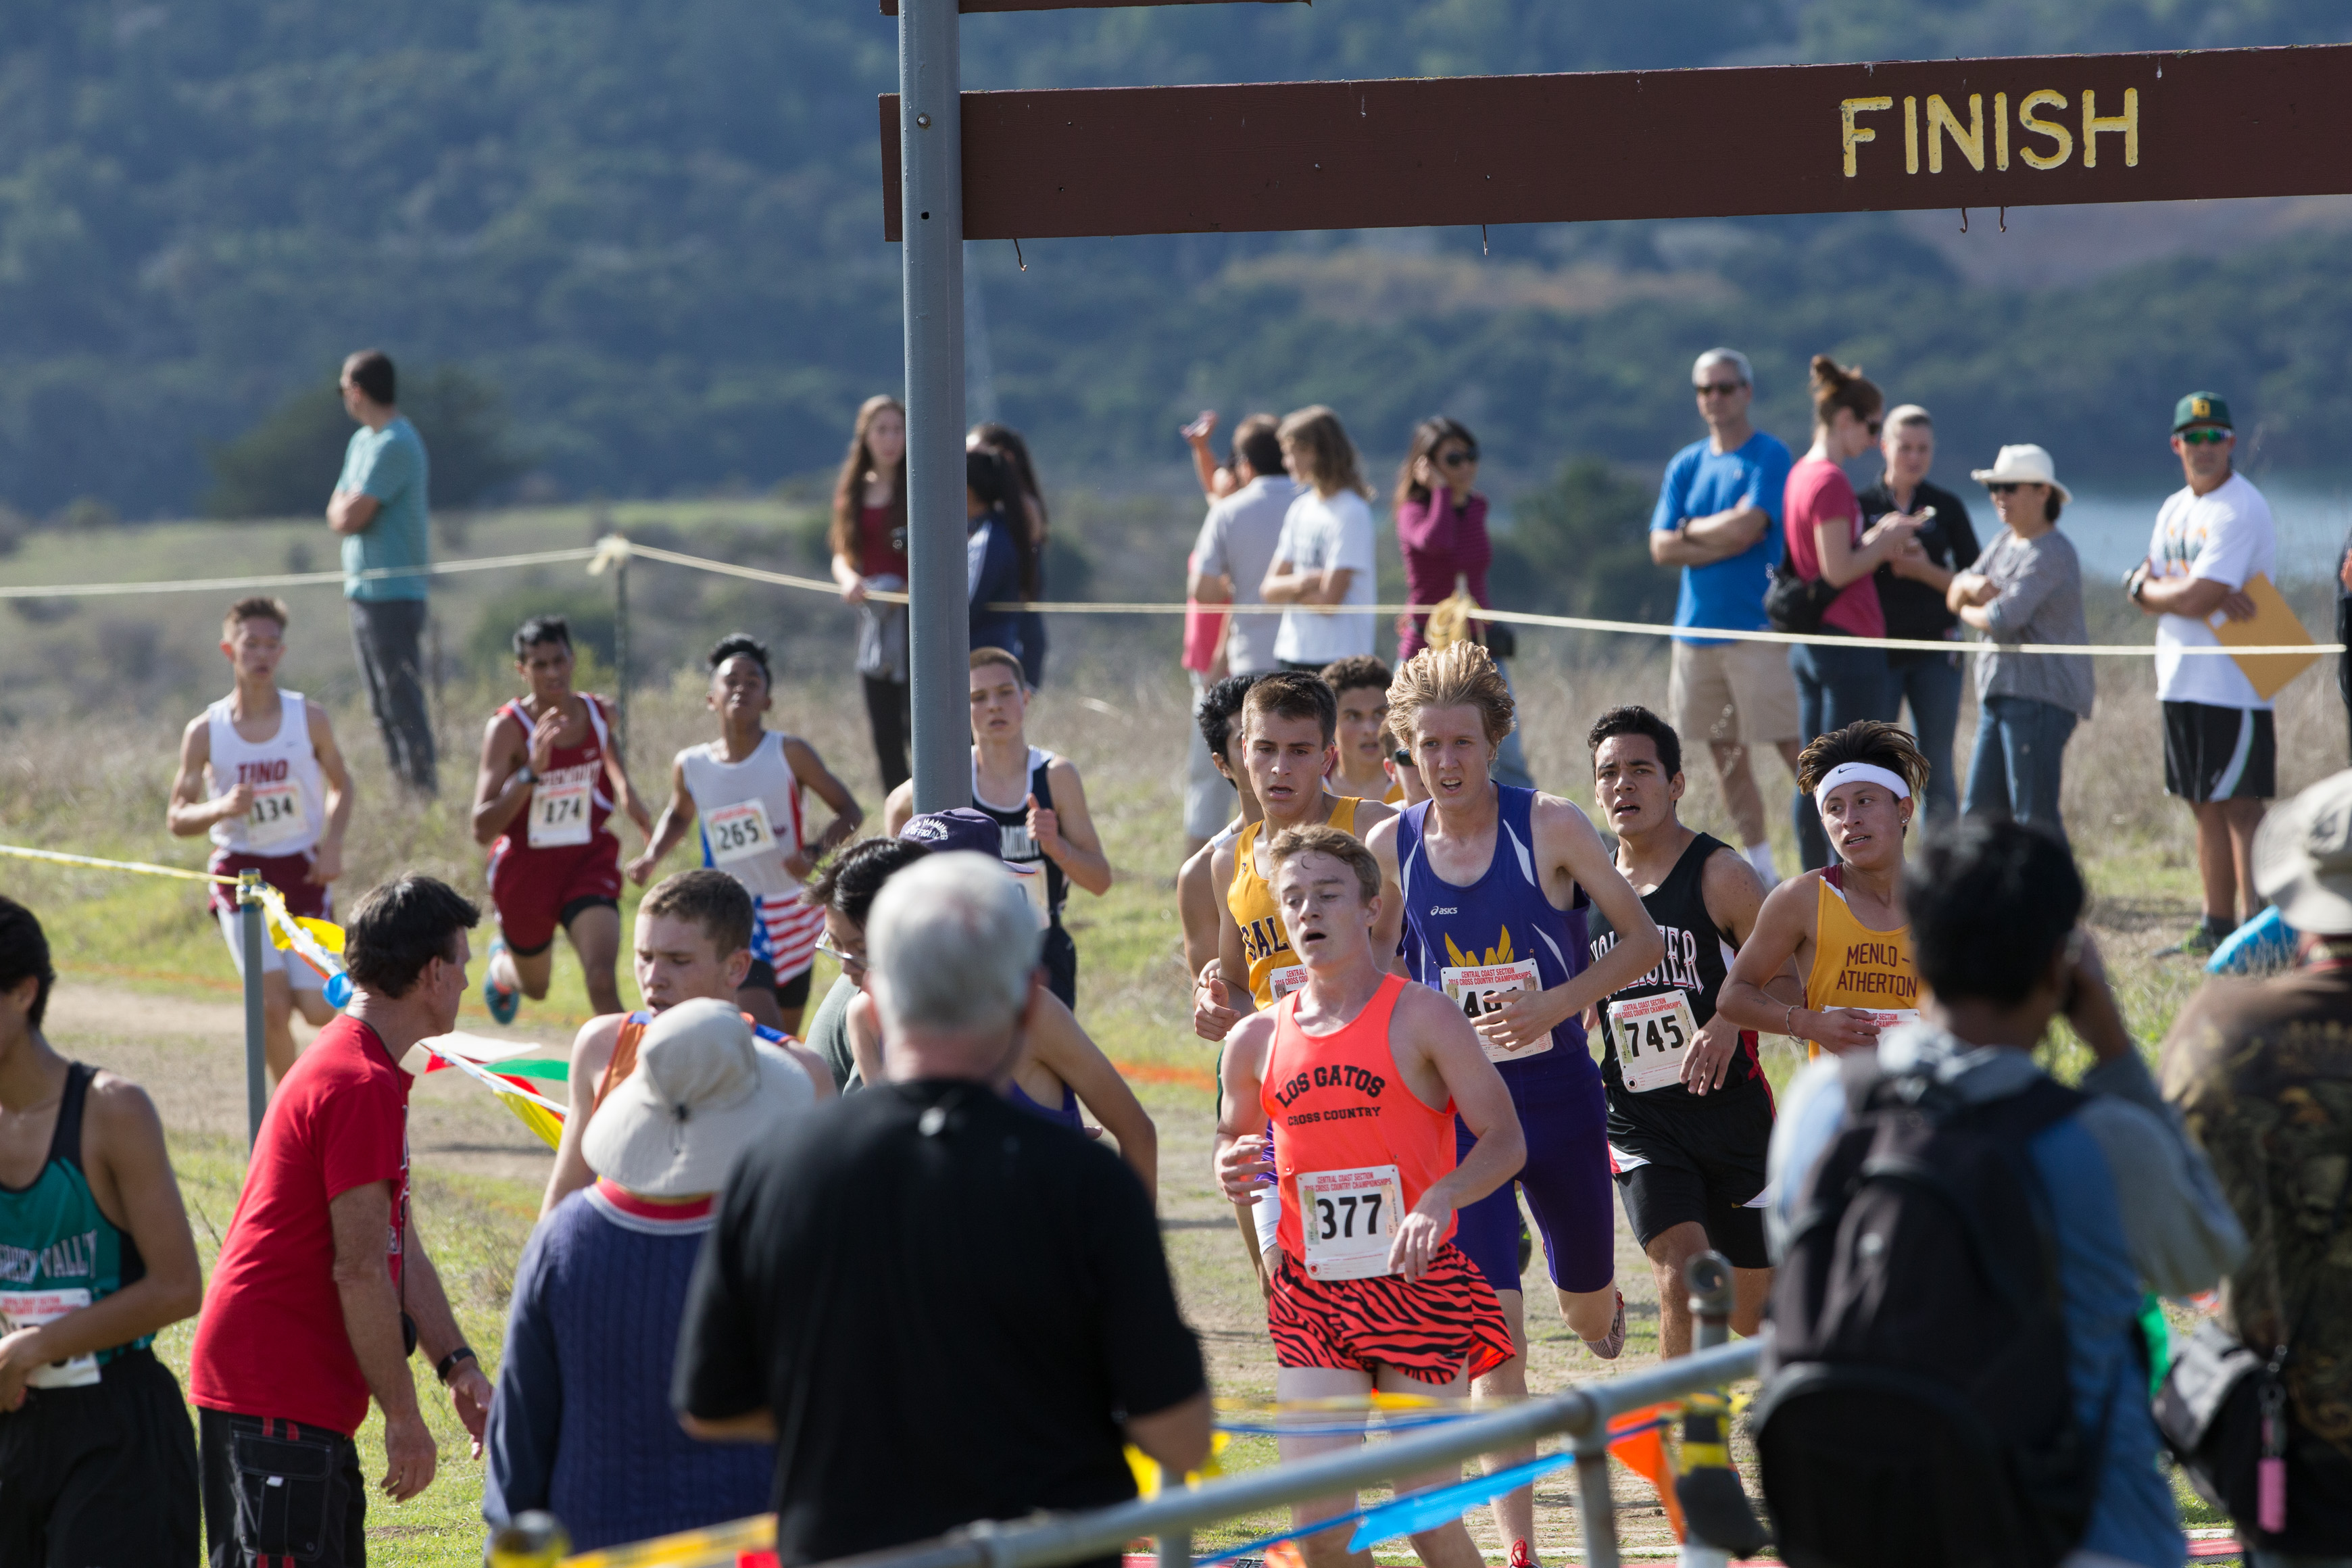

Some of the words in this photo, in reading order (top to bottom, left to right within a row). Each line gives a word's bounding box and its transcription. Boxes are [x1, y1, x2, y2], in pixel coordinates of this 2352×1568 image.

[1840, 87, 2138, 178] FINISH
[545, 796, 581, 823] 174
[717, 818, 760, 851] 265
[910, 827, 939, 840] OFFICIAL
[923, 818, 949, 840] HAMMER
[1439, 907, 1458, 915] asics
[1846, 942, 1898, 968] MENLO
[1285, 977, 1298, 985] CROSS
[1286, 969, 1305, 977] CENTRAL
[1474, 977, 1494, 985] COUNTRY
[1494, 971, 1532, 983] CHAMPIONSHIPS
[1481, 969, 1495, 977] COAST
[1496, 967, 1515, 975] SECTION
[1836, 970, 1918, 998] ATHERTON
[1622, 1003, 1638, 1012] CENTRAL
[1638, 1001, 1650, 1009] COAST
[1650, 997, 1667, 1006] SECTION
[1634, 1008, 1650, 1017] COUNTRY
[1650, 1000, 1682, 1013] CHAMPIONSHIPS
[1624, 1014, 1684, 1058] 745
[1275, 1072, 1310, 1108] LOS
[1314, 1064, 1386, 1098] GATOS
[1288, 1112, 1321, 1126] CROSS
[1323, 1106, 1381, 1121] COUNTRY
[1317, 1194, 1382, 1240] 377
